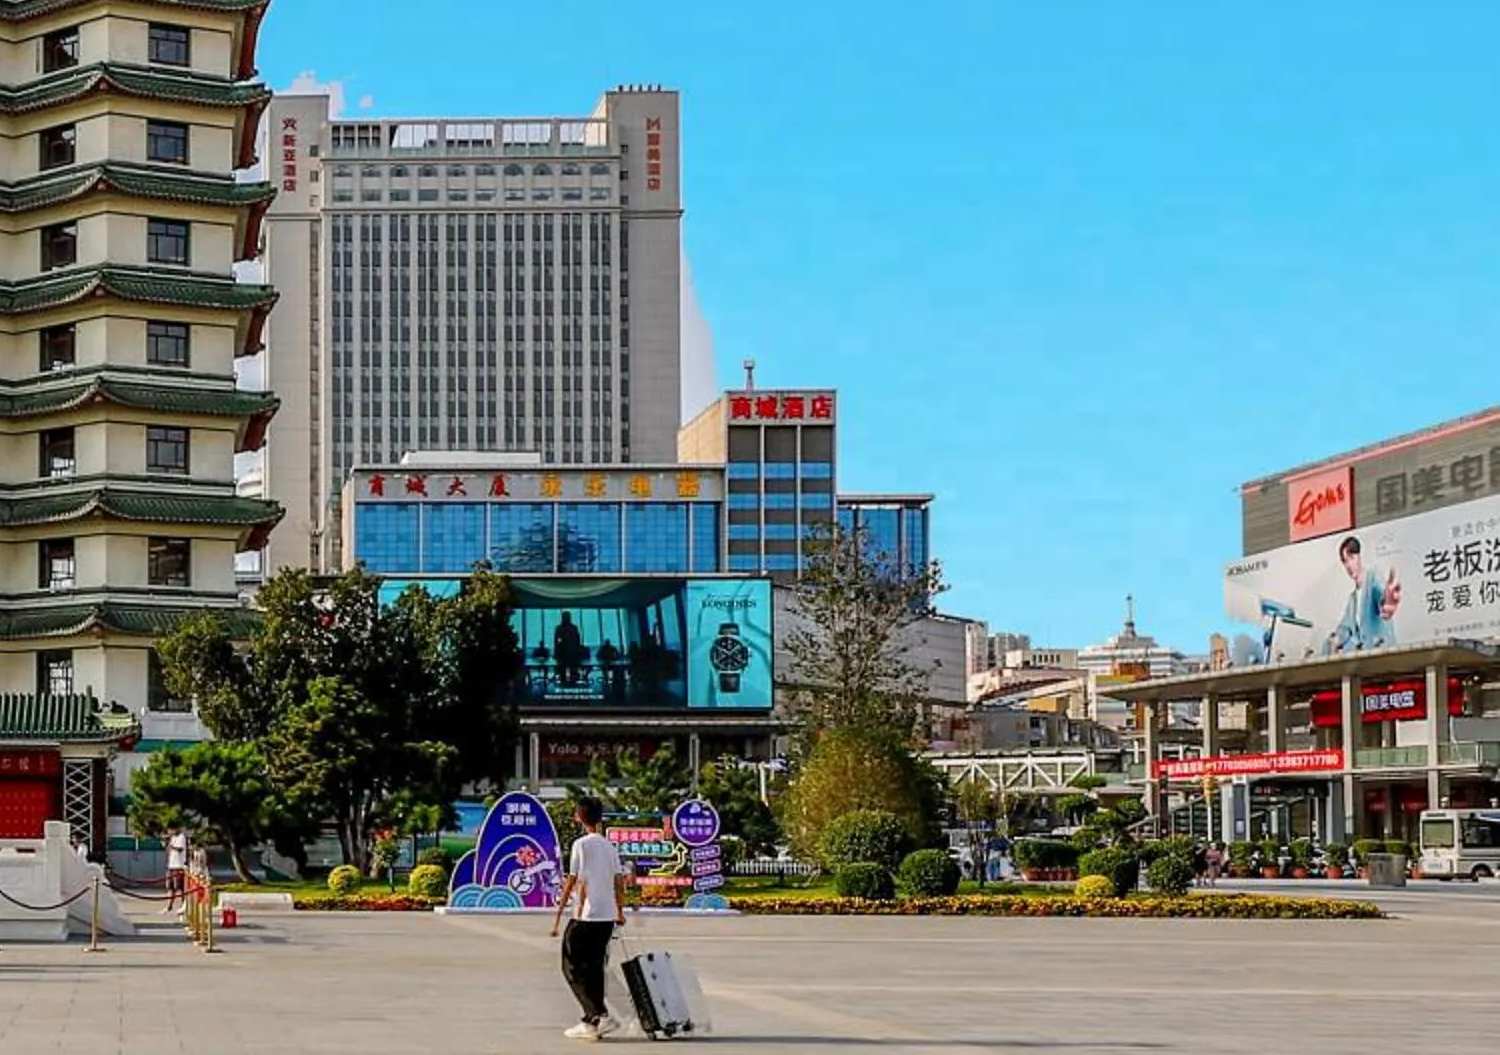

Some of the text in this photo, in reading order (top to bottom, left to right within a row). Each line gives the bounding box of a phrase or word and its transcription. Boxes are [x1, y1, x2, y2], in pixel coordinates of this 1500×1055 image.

[730, 396, 833, 419] 商城酒店
[368, 471, 510, 497] 商城大厦
